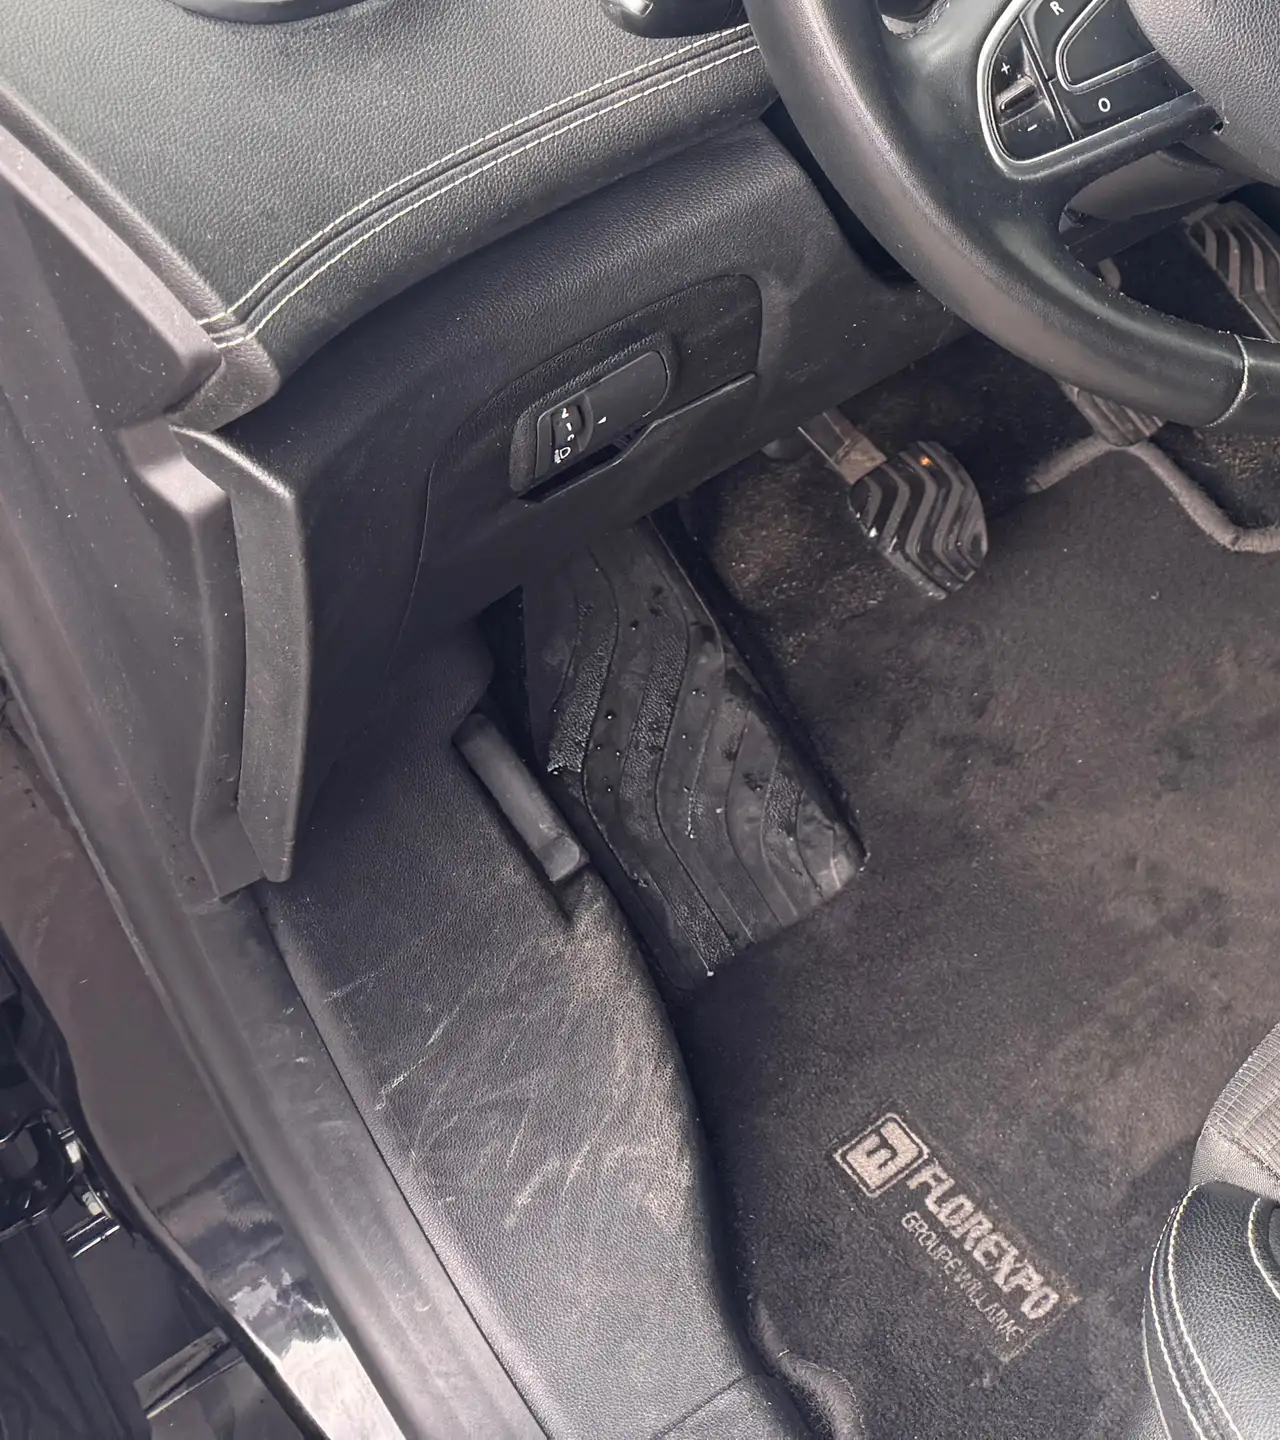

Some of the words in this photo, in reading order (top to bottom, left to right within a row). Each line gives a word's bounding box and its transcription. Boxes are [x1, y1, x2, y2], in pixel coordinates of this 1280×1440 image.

[1050, 1, 1064, 16] R
[901, 1210, 963, 1276] GROUPE
[906, 1158, 1060, 1320] FLOREXPO
